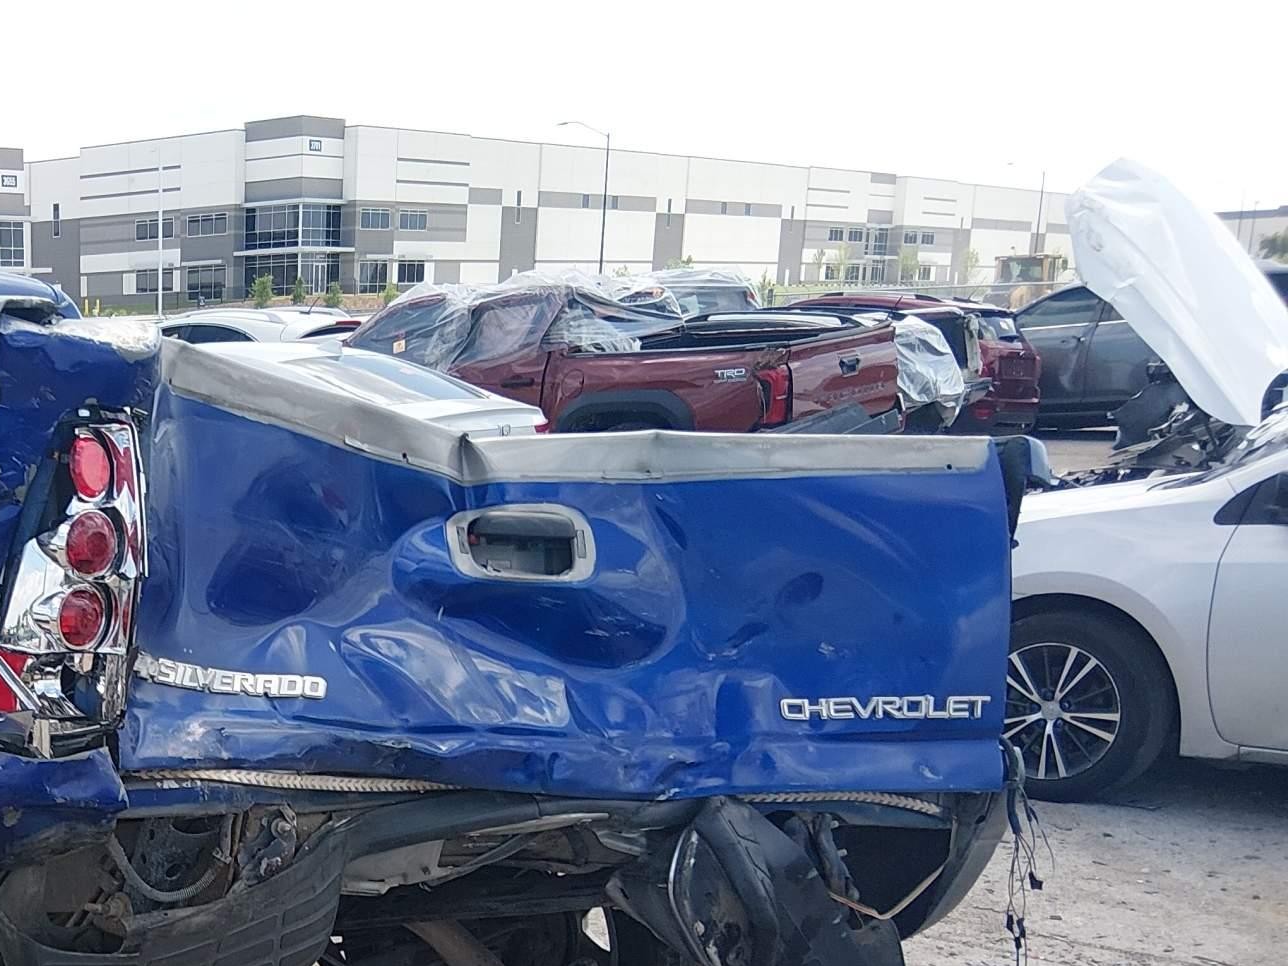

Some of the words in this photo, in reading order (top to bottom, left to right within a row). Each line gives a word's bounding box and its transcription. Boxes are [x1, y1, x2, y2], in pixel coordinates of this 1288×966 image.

[714, 368, 746, 379] TRD
[157, 658, 328, 700] SILVERADO
[780, 694, 992, 720] CHEVROLET
